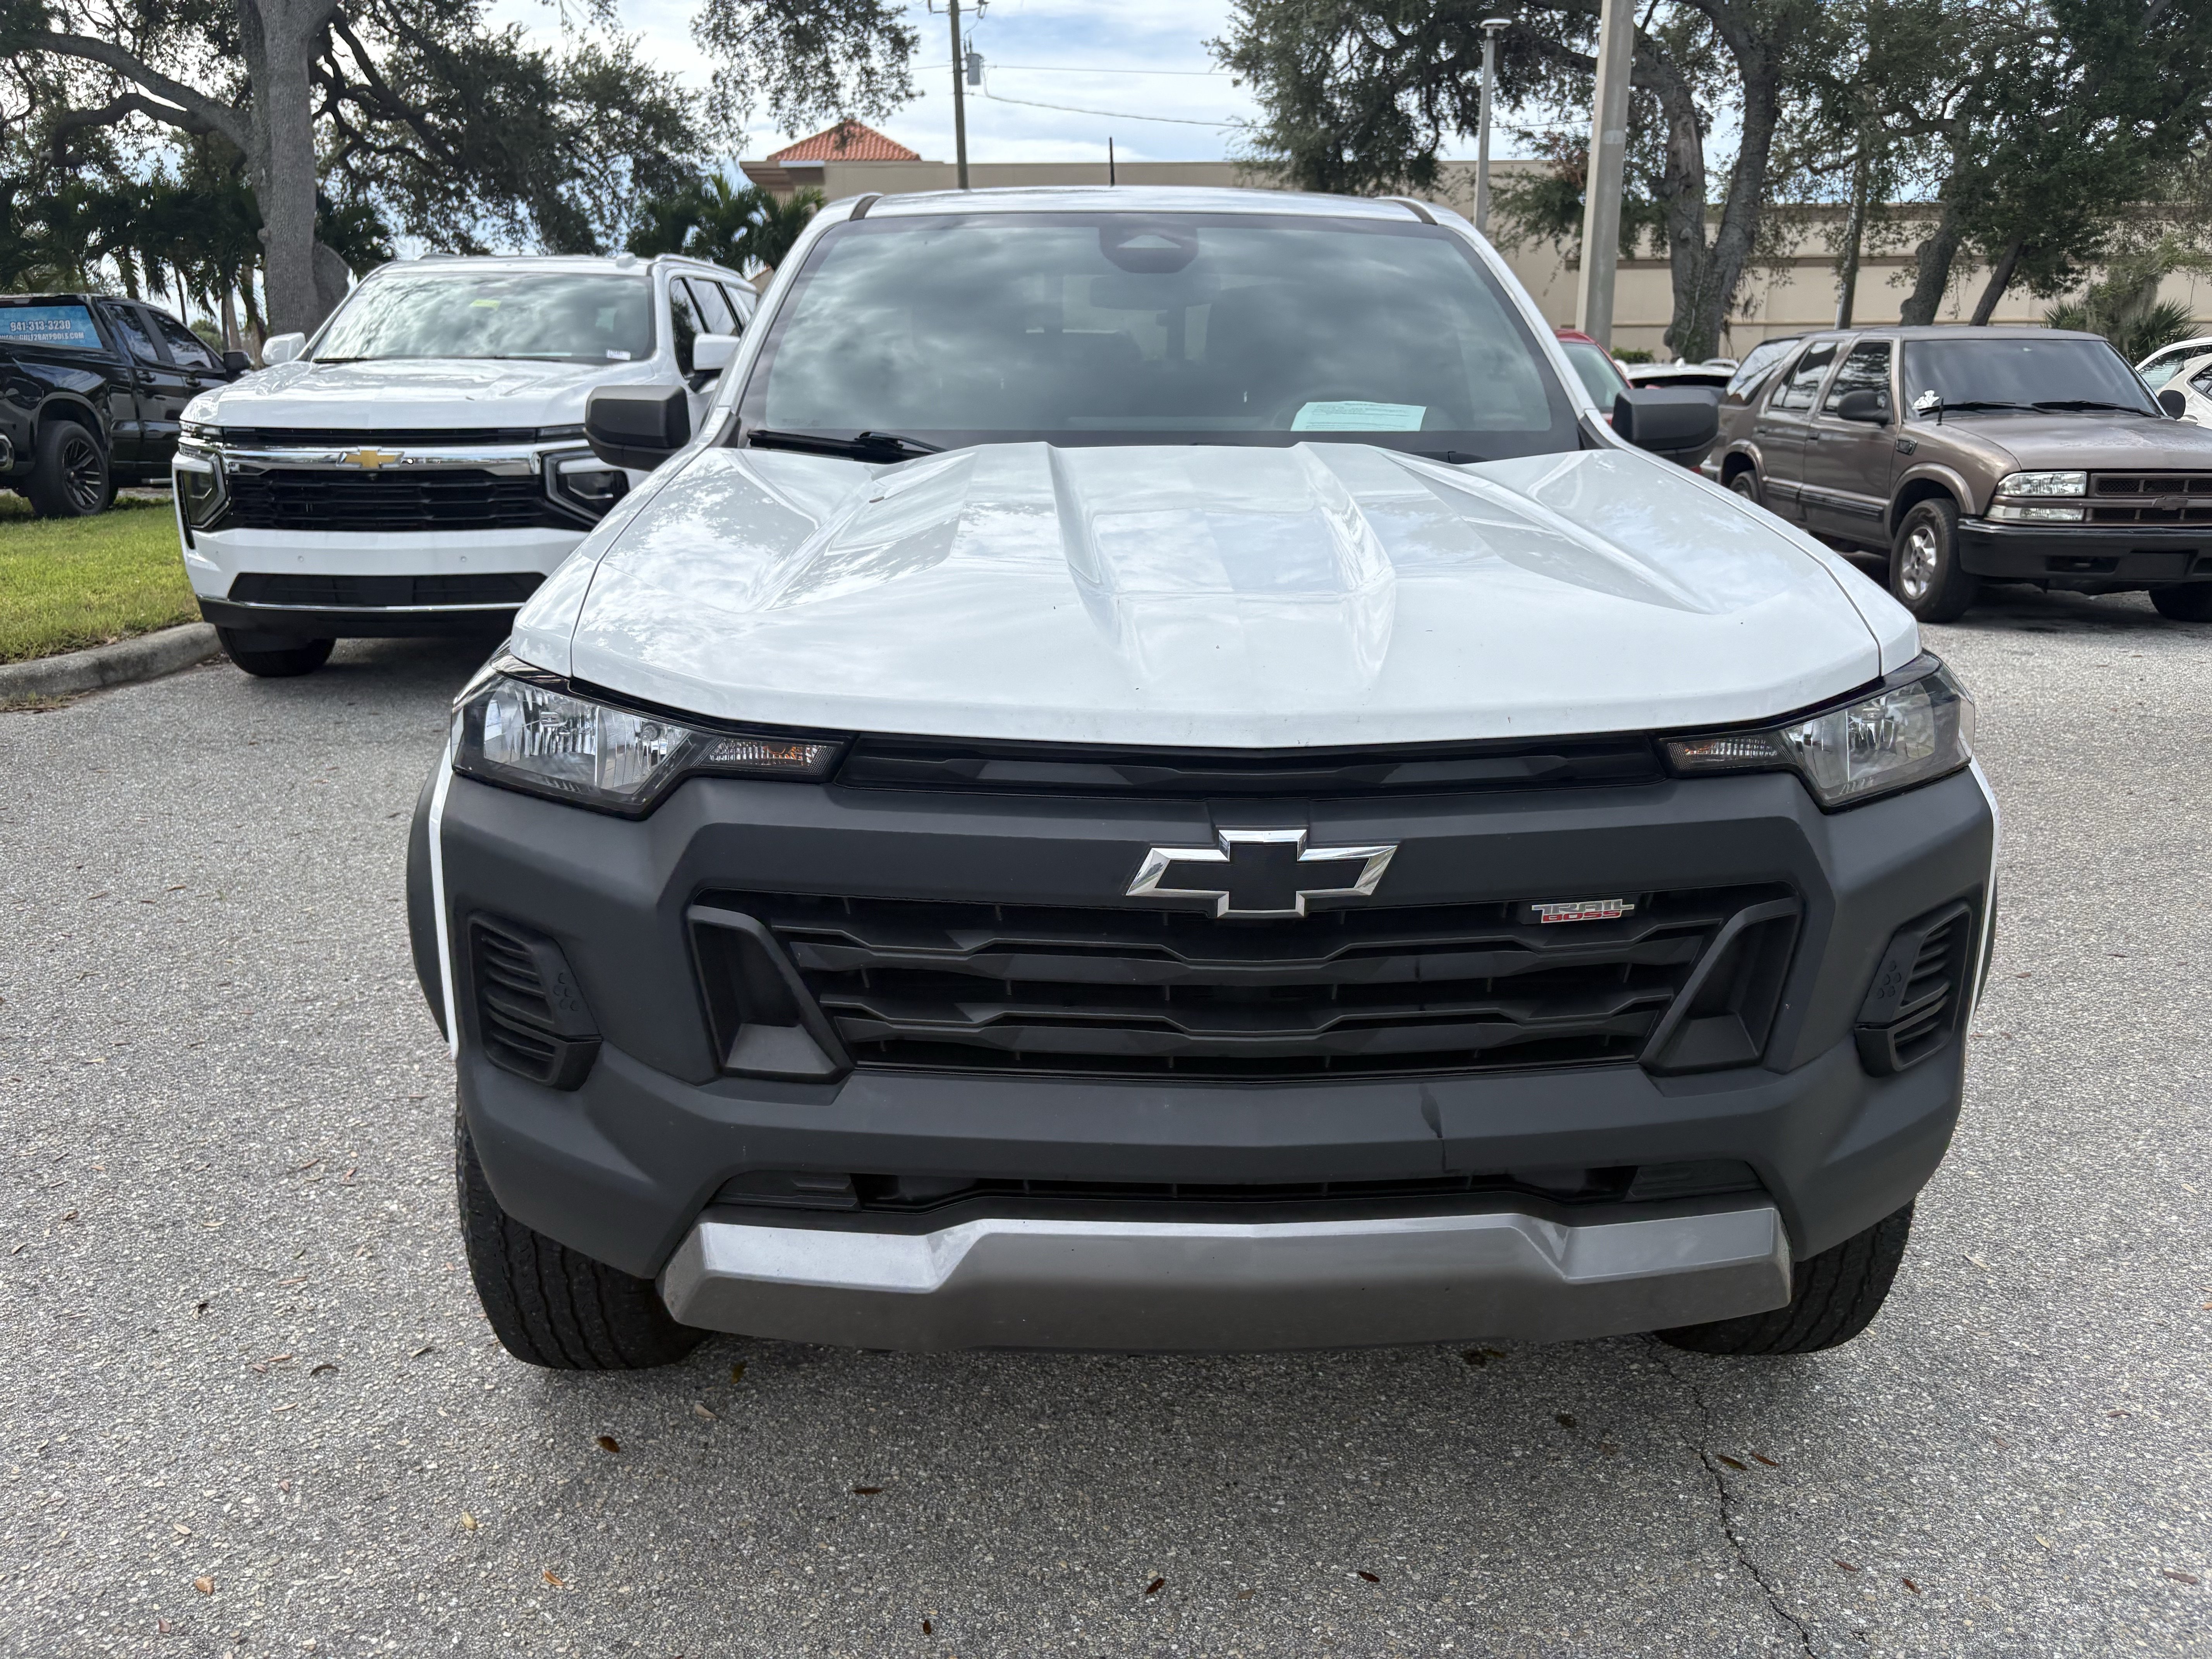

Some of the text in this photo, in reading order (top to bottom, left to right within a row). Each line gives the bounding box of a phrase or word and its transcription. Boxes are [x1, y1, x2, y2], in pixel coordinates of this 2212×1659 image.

[10, 320, 71, 331] 941-313-3230
[1532, 899, 1635, 914] TRAIL
[1541, 910, 1622, 923] BOSS
